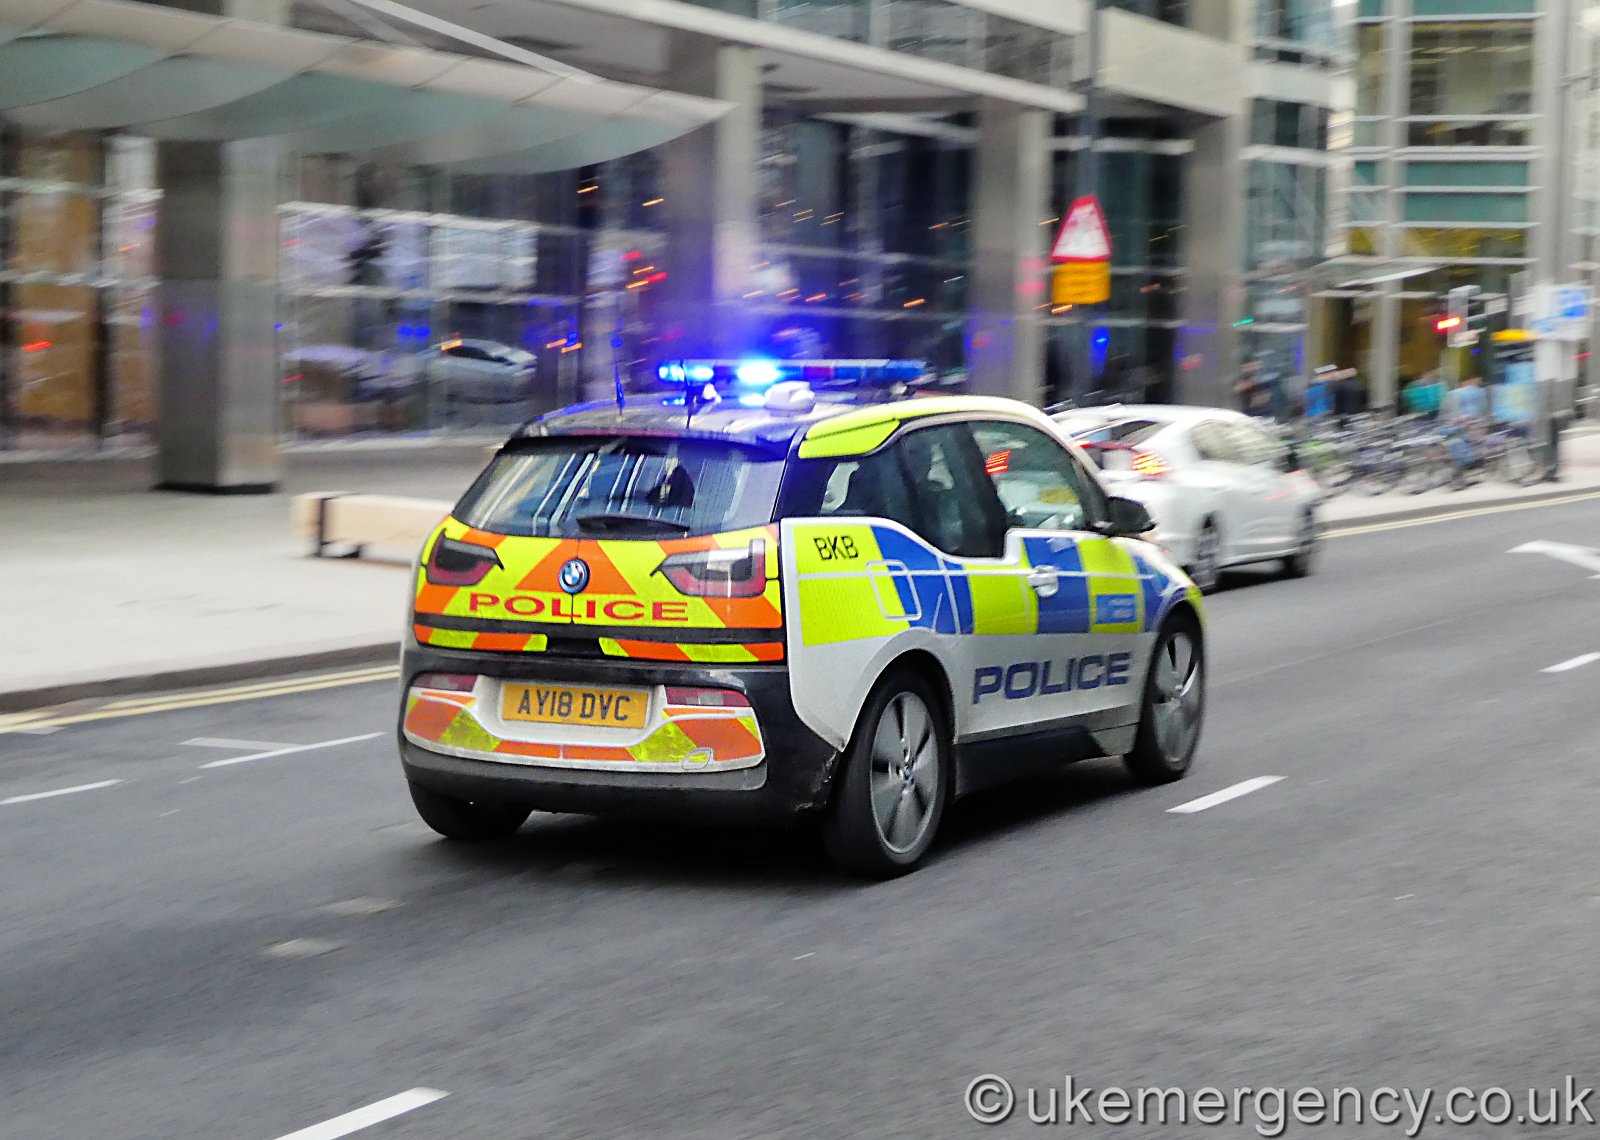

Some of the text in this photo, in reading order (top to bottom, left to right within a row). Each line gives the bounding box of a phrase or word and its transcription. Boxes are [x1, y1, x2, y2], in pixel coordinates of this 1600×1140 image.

[813, 535, 859, 560] BKB
[469, 592, 689, 622] POLICE
[972, 651, 1132, 705] POLICE
[517, 688, 631, 721] AY18 DVC
